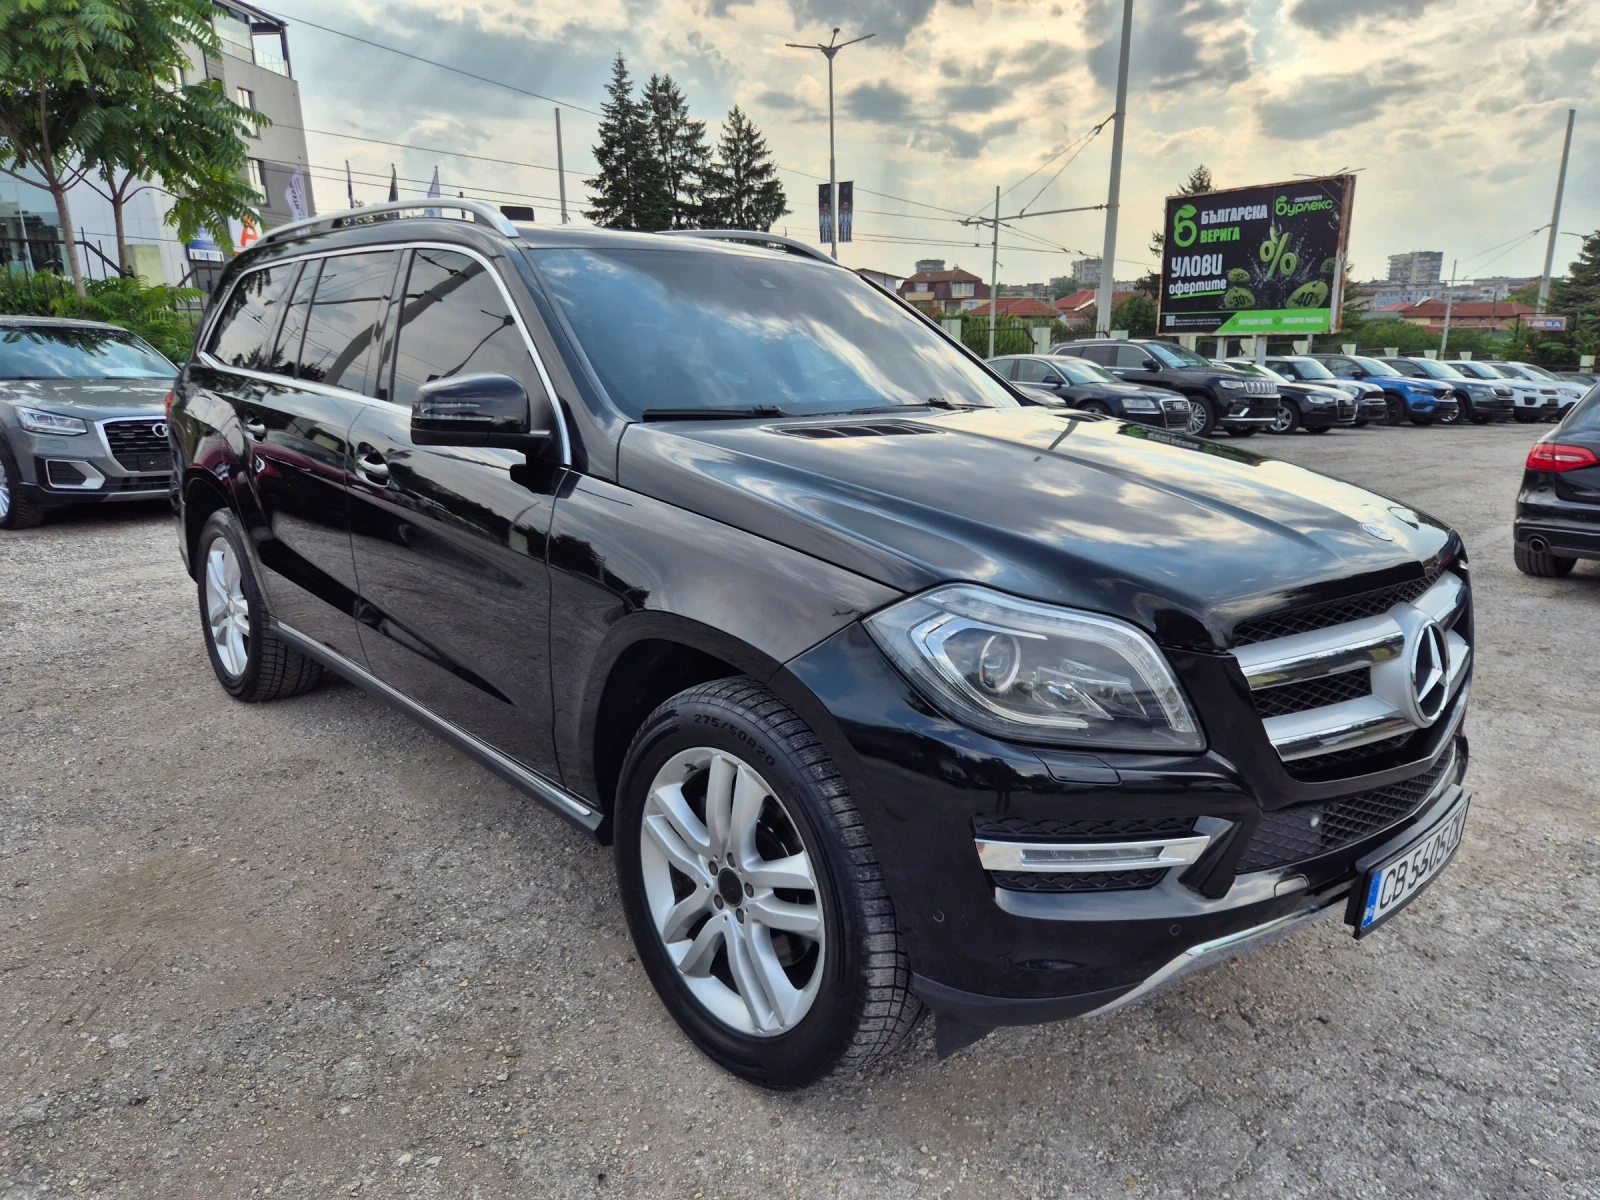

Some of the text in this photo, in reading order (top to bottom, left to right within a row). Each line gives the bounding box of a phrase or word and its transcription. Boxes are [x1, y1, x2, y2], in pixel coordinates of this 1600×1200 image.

[1201, 204, 1268, 225] БЪЛГАРСКА
[1200, 226, 1240, 243] ВЕРИГА
[1171, 253, 1223, 278] УЛОВИ
[1168, 278, 1227, 296] офертите
